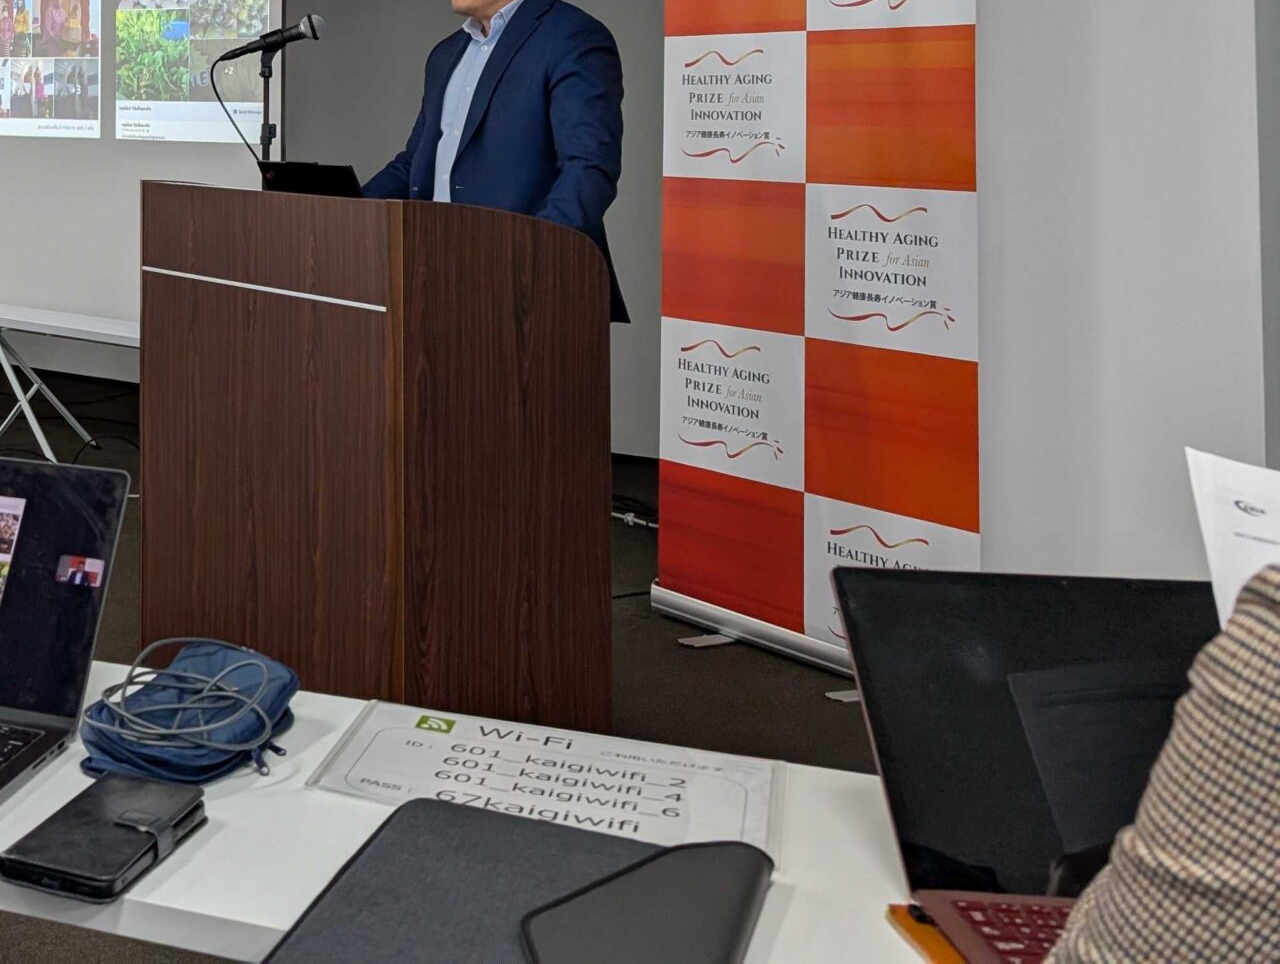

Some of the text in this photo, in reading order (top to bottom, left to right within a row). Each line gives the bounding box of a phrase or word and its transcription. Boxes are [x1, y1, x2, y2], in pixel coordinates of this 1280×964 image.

[681, 73, 772, 86] HEALTHY AGING
[689, 92, 764, 106] PRIZE for Asian
[690, 109, 762, 121] INNOVATION
[686, 131, 770, 139] アジア健康長寿イノベーション賞
[828, 226, 939, 248] HEALTHY AGING
[836, 247, 929, 268] PRIZE for Asian
[840, 266, 927, 287] INNOVATION
[833, 289, 937, 309] アジア健康長寿イノベーション賞
[678, 358, 770, 384] HEALTHY AGING
[685, 377, 762, 402] PRIZE for Asian
[687, 395, 759, 420] INNOVATION
[681, 416, 768, 441] アジア健康長寿イノベーション賞
[827, 541, 888, 568] HEALTHY
[479, 725, 574, 751] Wi-Fi
[450, 742, 686, 789] 601_kaigiwifi_2
[442, 755, 683, 803] 601_kaigiwifi_4
[434, 769, 681, 818] 601_kaigiwifi_6
[435, 790, 640, 834] 67kaigiwifi
